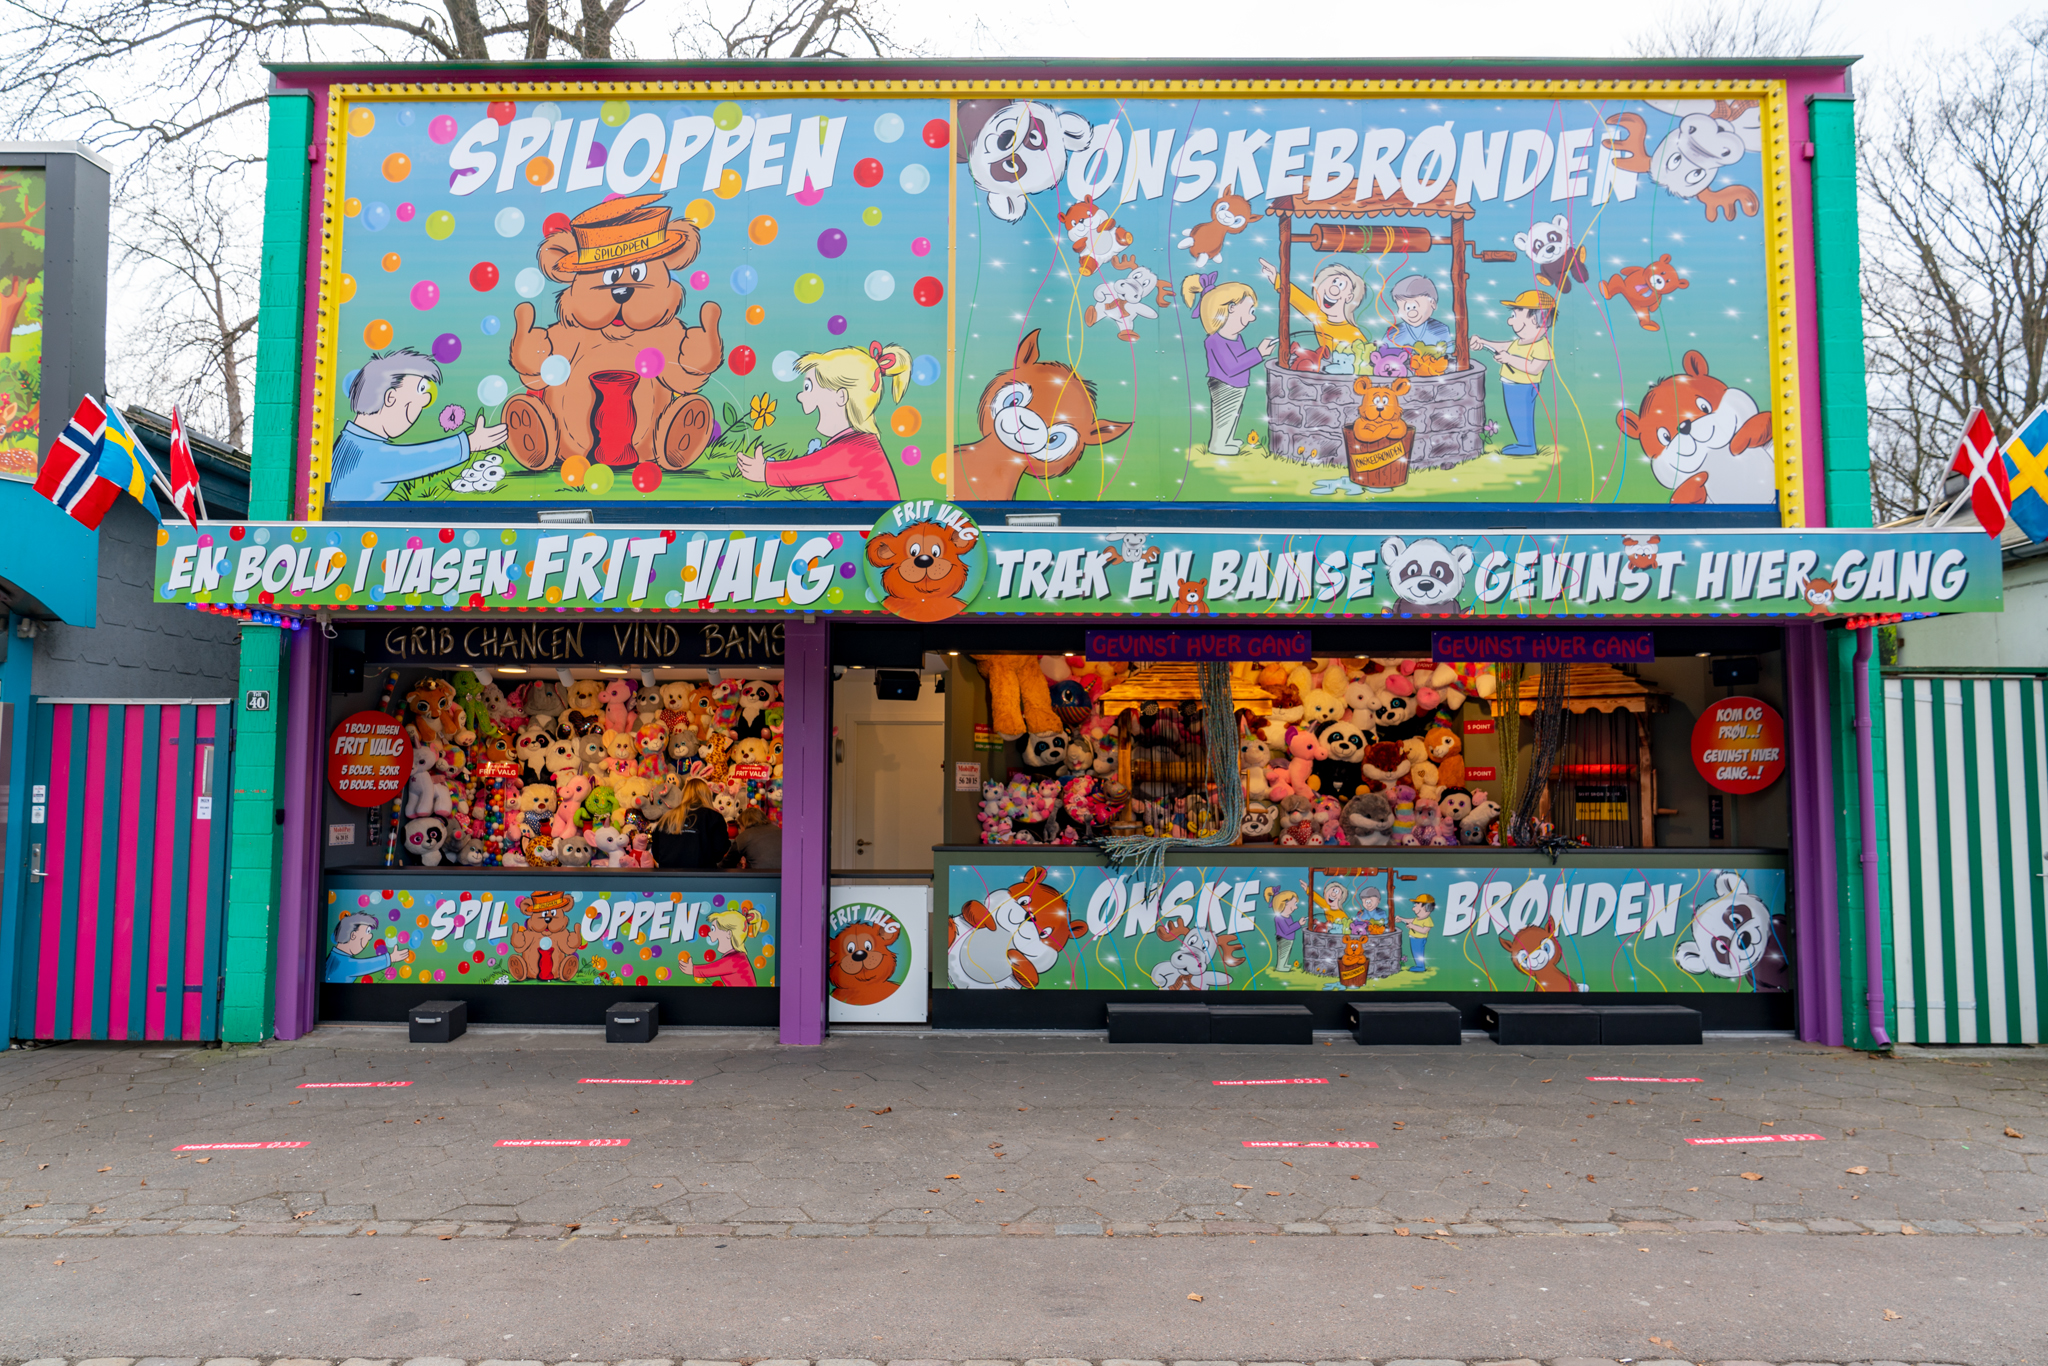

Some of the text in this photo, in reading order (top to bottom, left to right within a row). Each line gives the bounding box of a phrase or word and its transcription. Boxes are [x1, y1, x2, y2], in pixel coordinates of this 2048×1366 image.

[448, 112, 848, 197] SPILOPPEN
[1066, 117, 1639, 209] ØNSKEBRØNDEN
[593, 236, 650, 262] SPILOPPEN
[892, 500, 980, 541] FRIT VALG
[167, 535, 836, 605] EN BOLD I VASEN FRIT VALG
[995, 547, 1969, 604] TRÆK EN BAMSE GEVINST HVER GANG
[384, 625, 455, 660] GRIB
[463, 621, 584, 660] CHANCEN
[613, 622, 681, 659] VIND
[1092, 634, 1305, 657] GEVINST HVER GANG
[1437, 635, 1651, 658] GEVINST HVER GANG
[249, 697, 266, 709] 40
[1715, 706, 1763, 722] KOM OG
[345, 722, 400, 736] 1 BOLD I VASEN
[334, 735, 404, 757] FRIT VALG
[1702, 747, 1780, 763] GEVINST HVER
[340, 764, 348, 775] 5
[378, 765, 400, 776] 30KR
[749, 770, 767, 778] VALG
[965, 776, 972, 785] 20
[972, 776, 979, 785] 15
[339, 779, 350, 790] 10
[378, 779, 399, 790] 50KR
[829, 904, 901, 934] FRIT VALG
[1086, 874, 1683, 941] ØNSKE BRØNDEN
[430, 898, 702, 944] SPIL OPPEN
